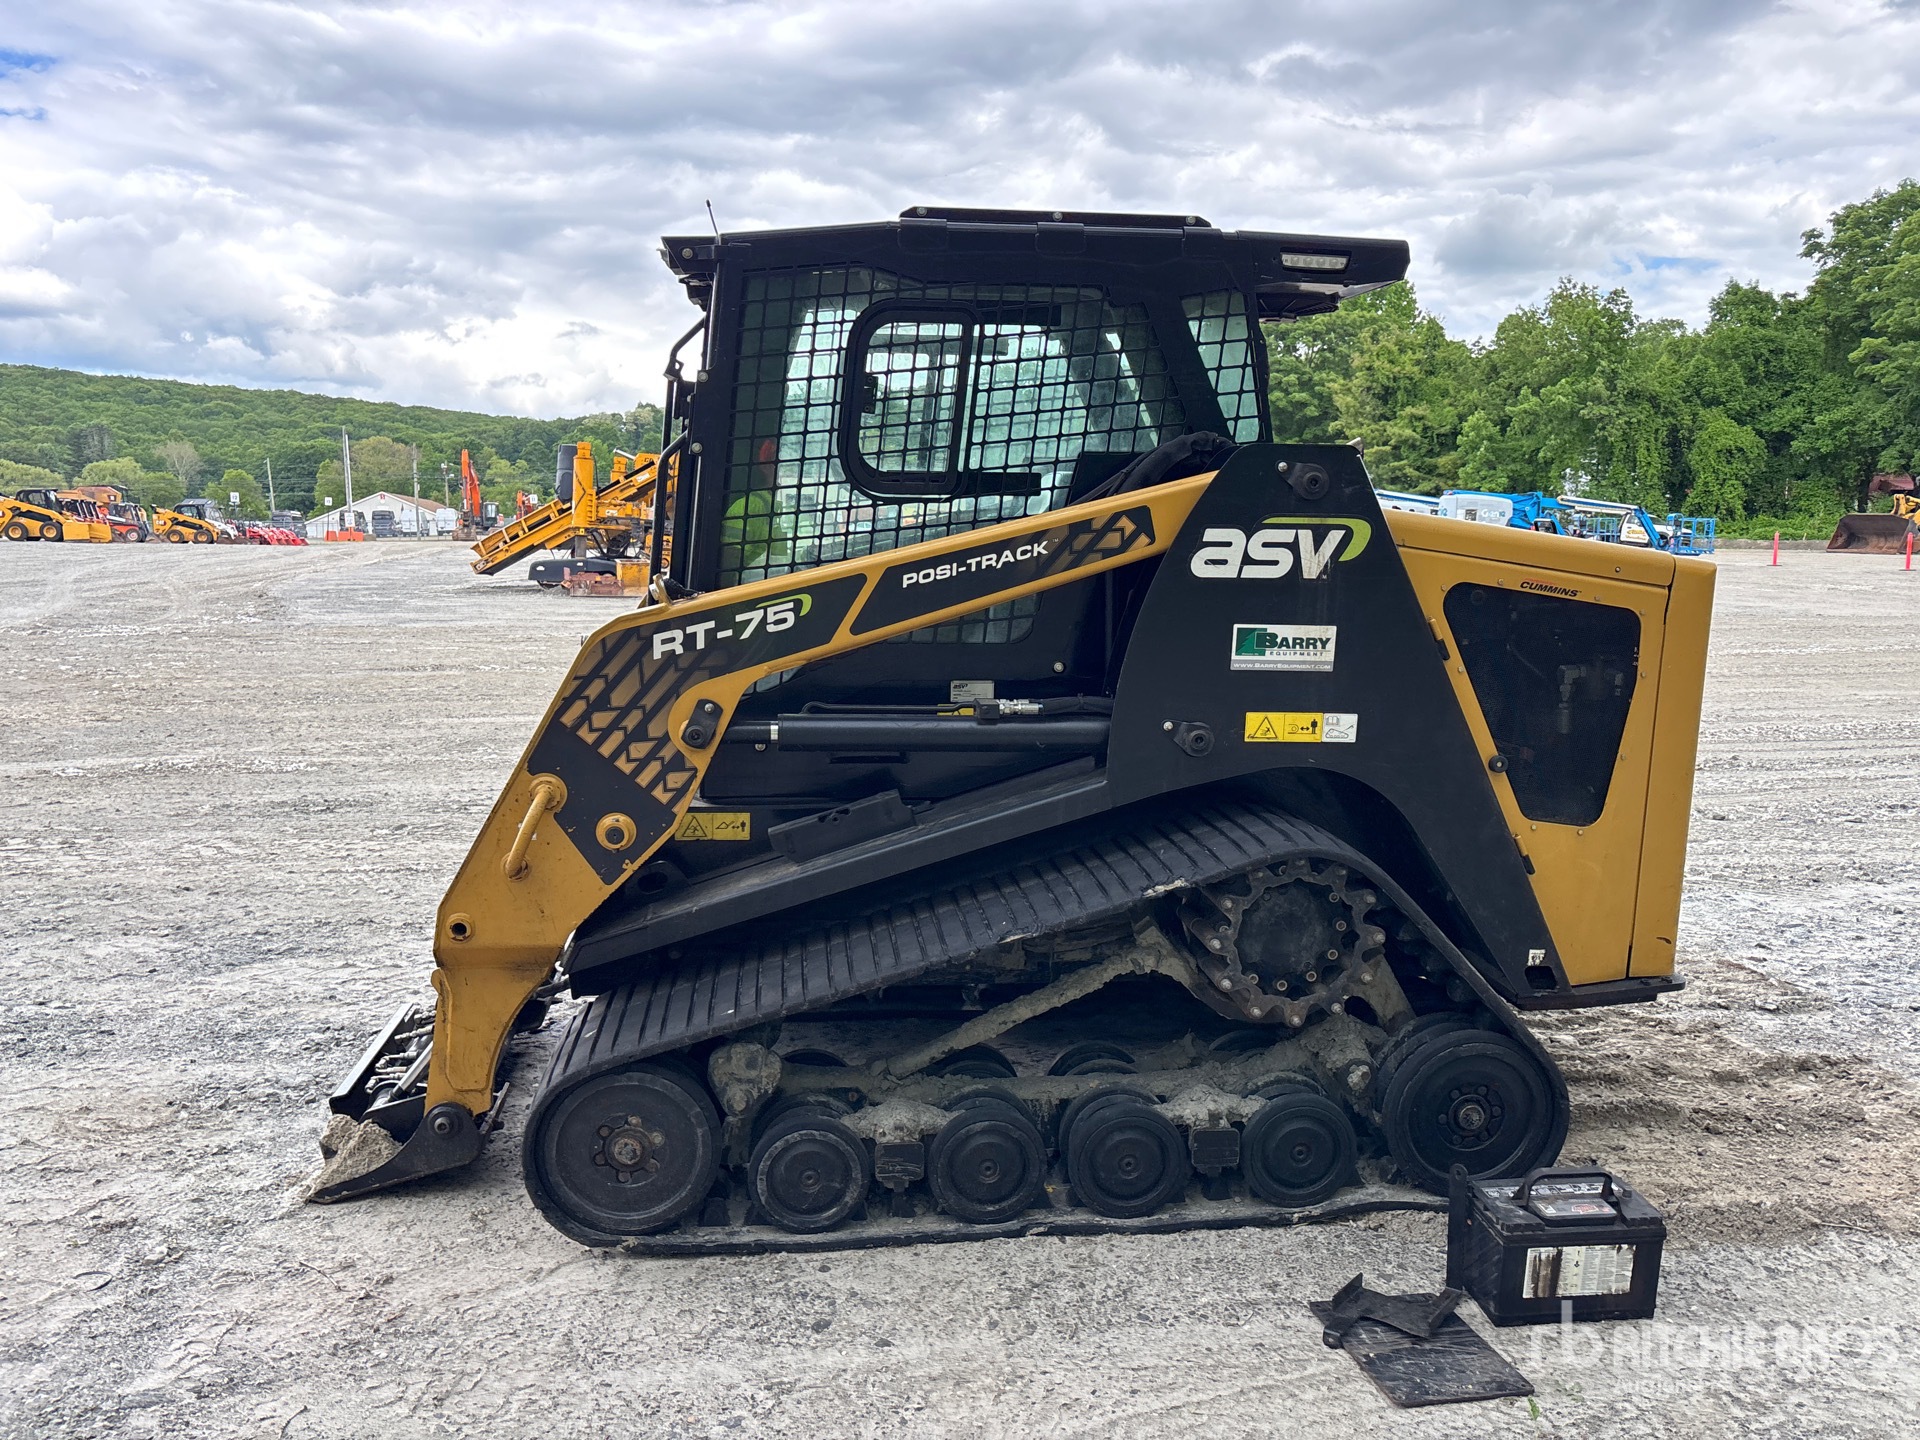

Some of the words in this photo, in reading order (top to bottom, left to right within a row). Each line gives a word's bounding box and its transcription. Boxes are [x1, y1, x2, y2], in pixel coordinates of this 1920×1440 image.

[902, 540, 1049, 589] POSI-TRACK
[1520, 581, 1579, 597] CUMMINS
[652, 601, 796, 661] RT-75
[1255, 631, 1331, 650] BARRY
